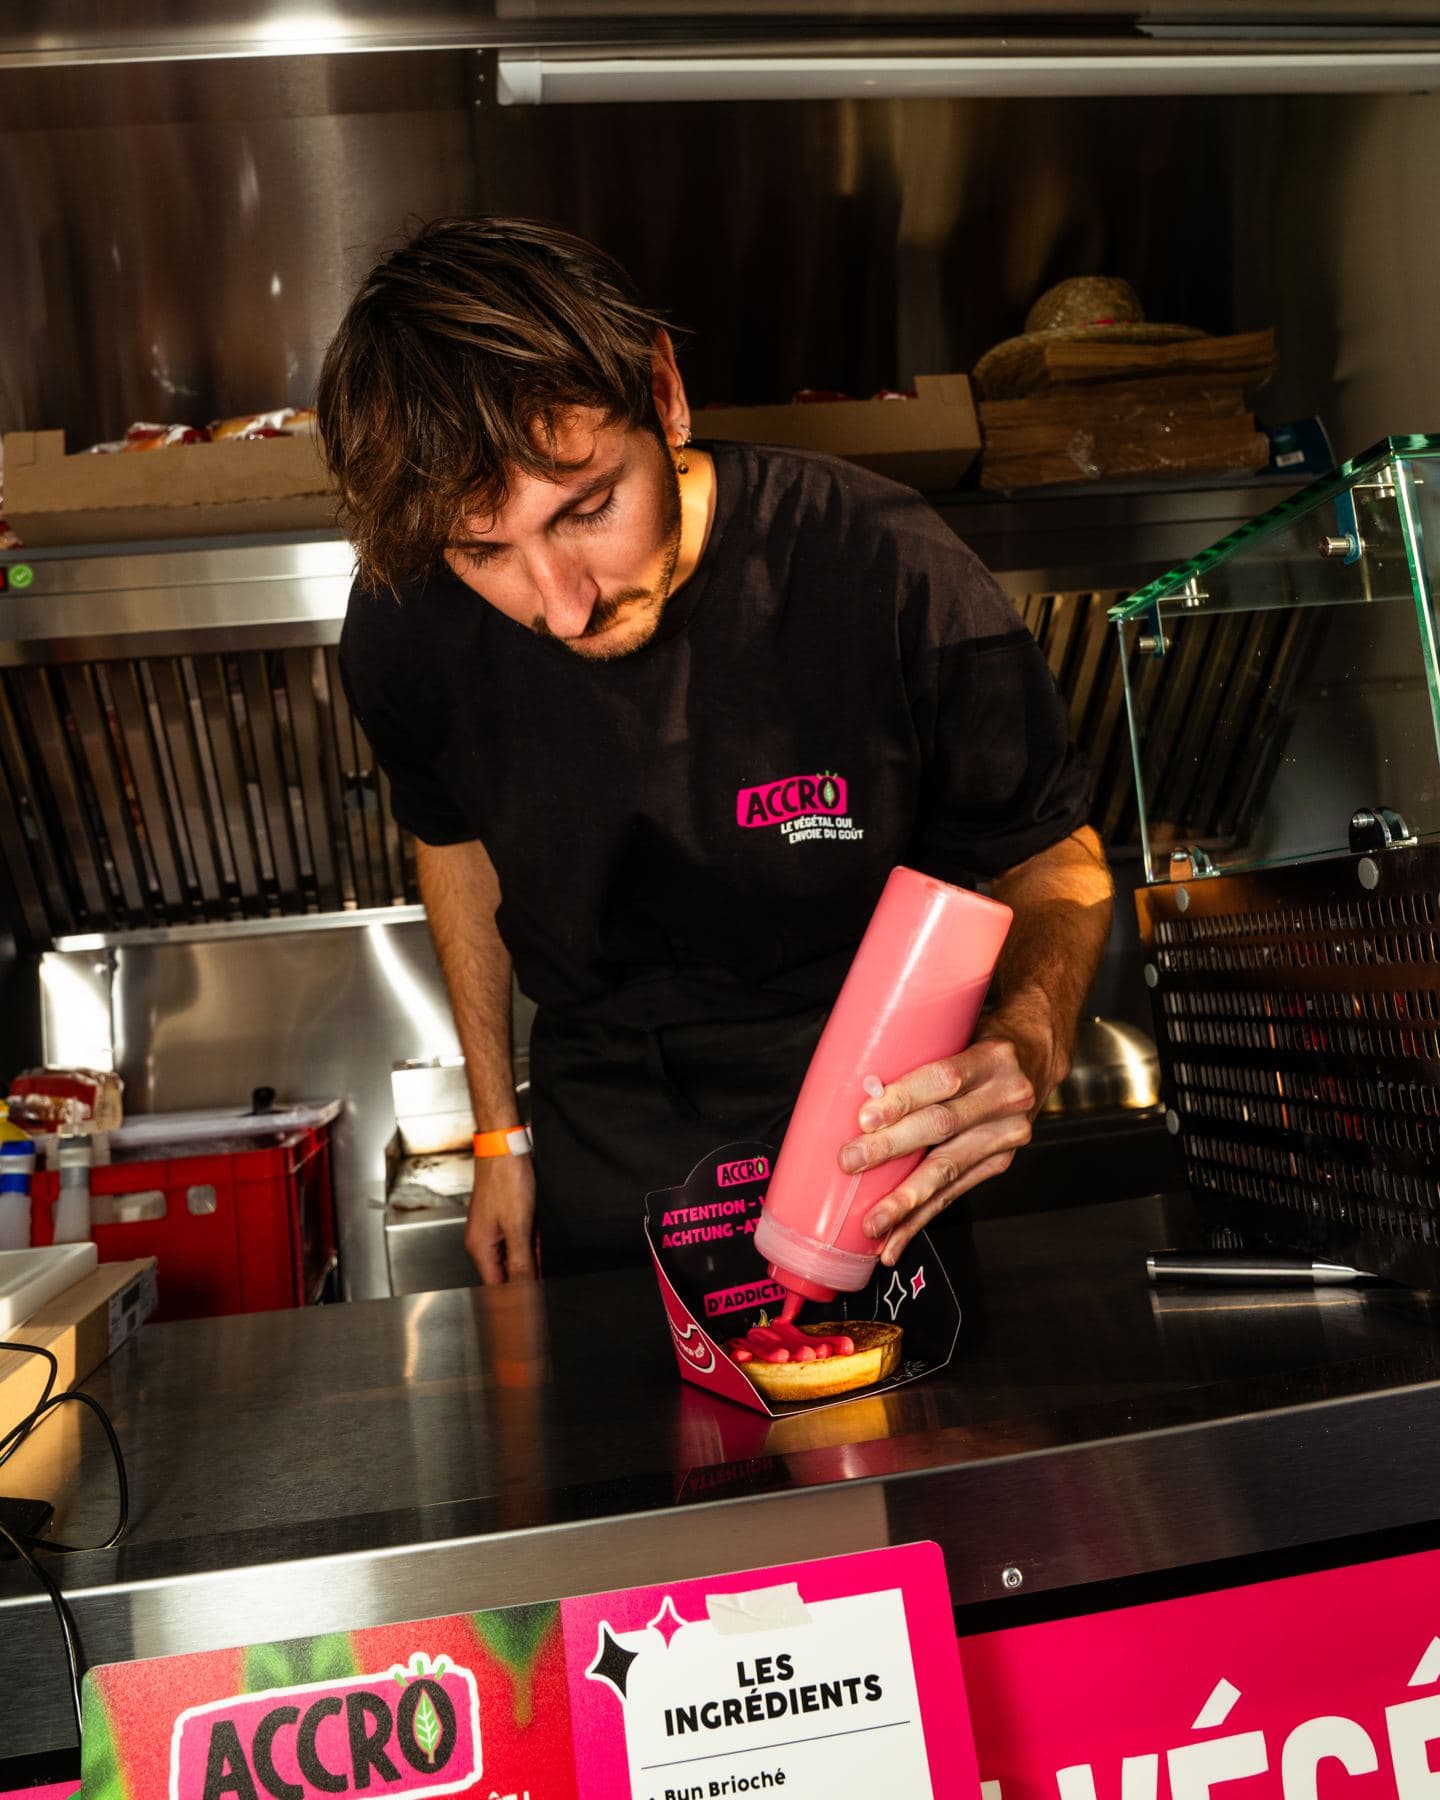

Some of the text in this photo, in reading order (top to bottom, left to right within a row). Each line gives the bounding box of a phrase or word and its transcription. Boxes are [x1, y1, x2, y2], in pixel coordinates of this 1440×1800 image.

[746, 778, 840, 825] ACCRO
[781, 821, 793, 834] LE
[793, 814, 834, 830] VÉGÉTAL
[788, 827, 864, 845] ENVOIE DU GOÛT
[721, 1159, 765, 1185] ACCRO
[661, 1198, 746, 1227] ATTENTION
[662, 1222, 734, 1249] ACHTUNG
[737, 1653, 795, 1688] LES
[664, 1674, 883, 1737] INGRÉDIENTS
[203, 1679, 457, 1800] ACCRO
[708, 1768, 787, 1798] Brioché
